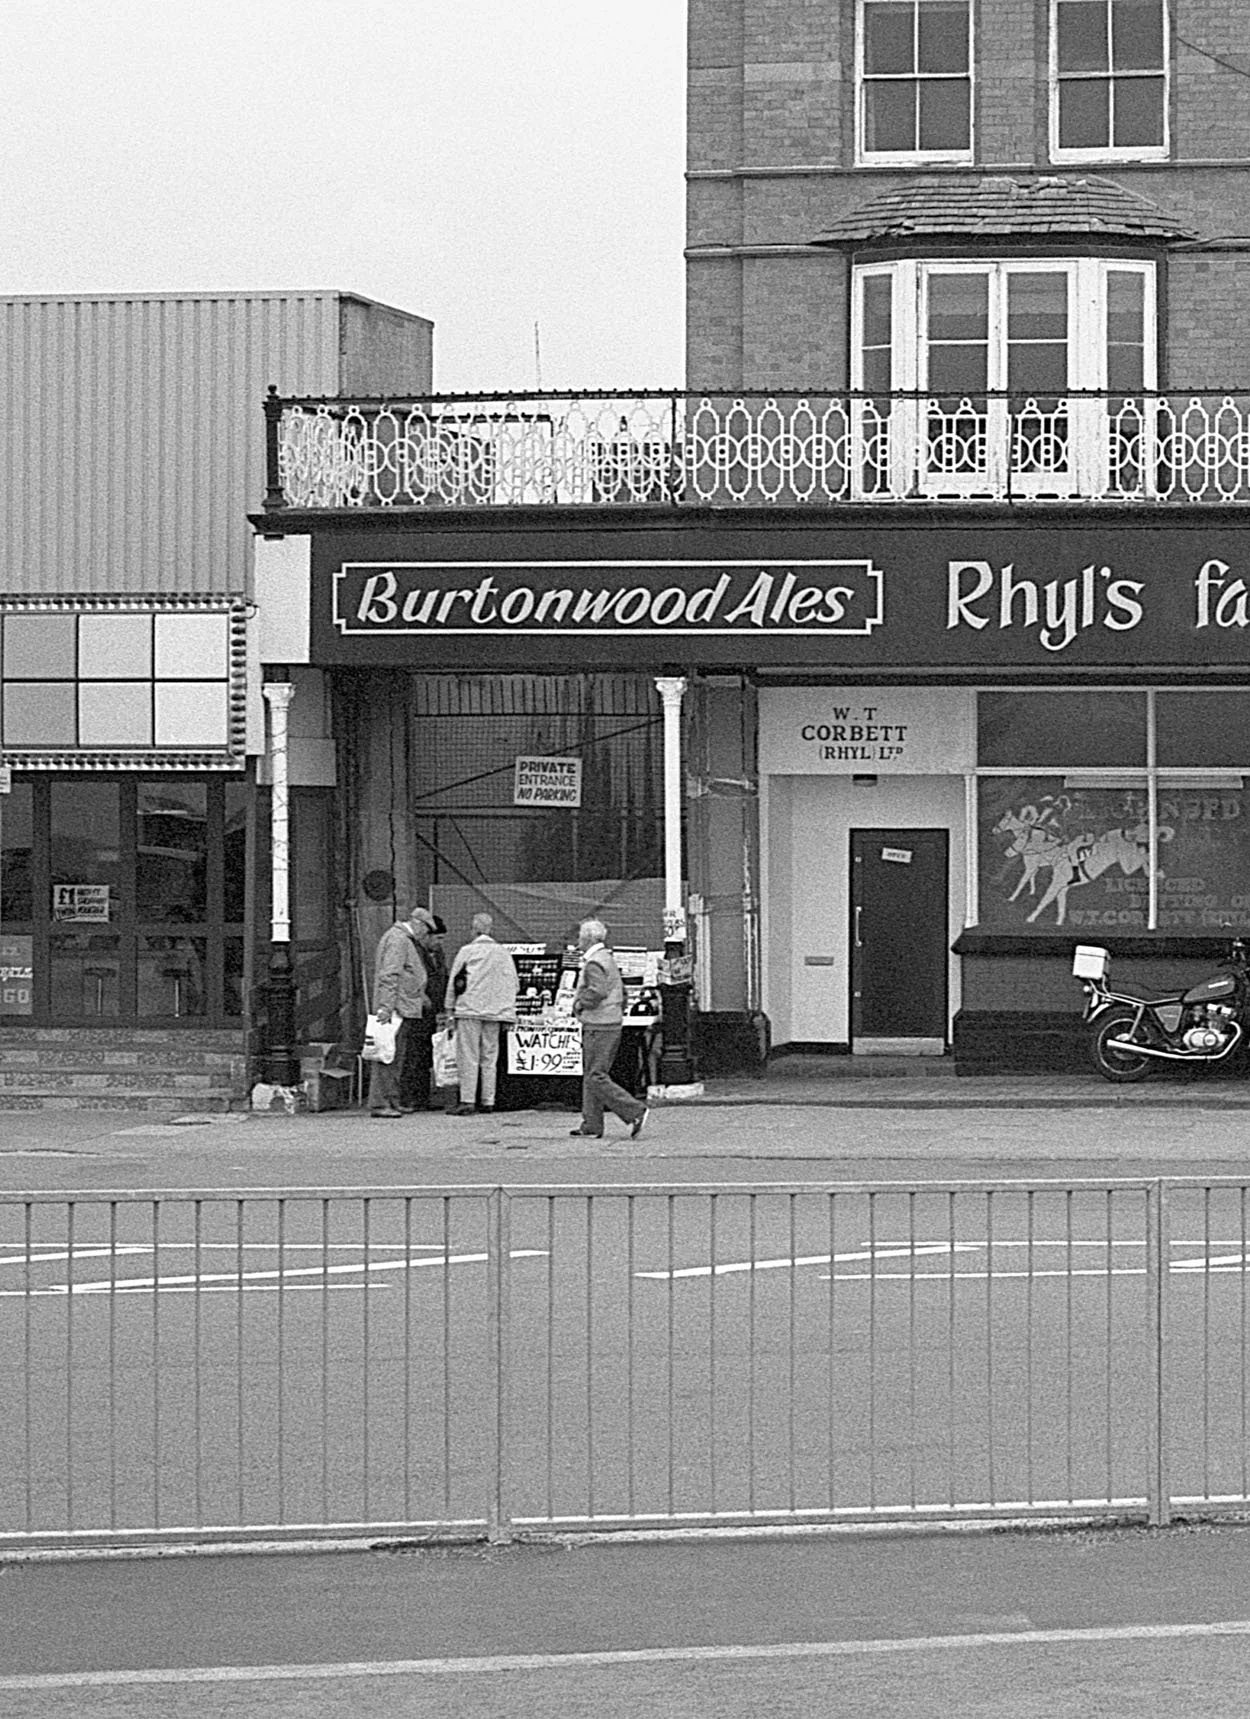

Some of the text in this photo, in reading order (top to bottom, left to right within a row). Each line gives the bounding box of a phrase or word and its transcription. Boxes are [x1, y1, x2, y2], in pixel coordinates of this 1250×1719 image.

[357, 571, 855, 627] Burtonwood Ales
[946, 560, 1145, 651] Rhyl's
[801, 725, 908, 741] CORBETT
[819, 745, 876, 760] (RHYL)
[520, 761, 576, 774] PRIVATE
[520, 774, 576, 787] ENTRANCE
[517, 788, 577, 801] NO PARKING
